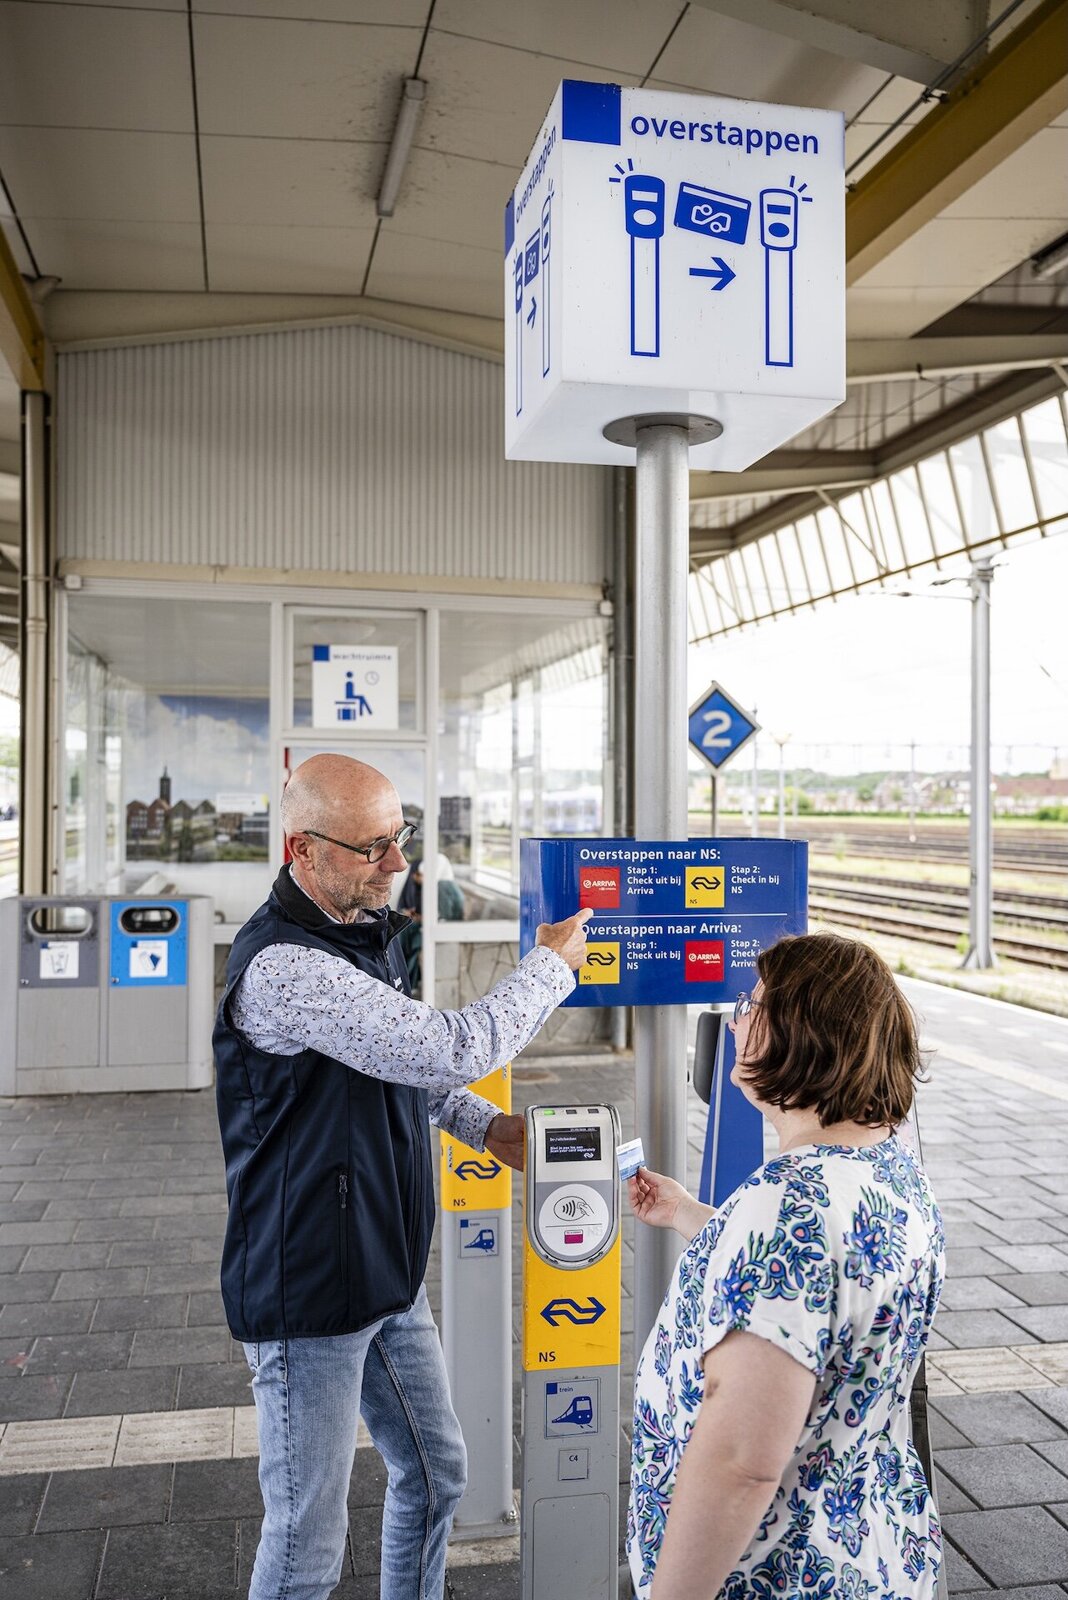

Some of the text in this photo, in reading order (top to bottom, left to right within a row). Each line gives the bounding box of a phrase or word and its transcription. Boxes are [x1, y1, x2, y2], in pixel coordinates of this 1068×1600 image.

[631, 115, 818, 156] overstappen
[516, 125, 556, 223] overstappen
[702, 709, 732, 747] 2
[580, 848, 721, 862] Overstappen naar NS:
[627, 866, 658, 876] Stap 1:
[731, 866, 760, 875] Stap 2:
[627, 876, 682, 886] Check uit bij
[731, 875, 780, 885] Check in bij
[627, 887, 654, 895] Arriva
[731, 886, 743, 894] NS
[667, 924, 696, 935] naar
[699, 922, 742, 934] Arriva:
[627, 941, 657, 950] Stap 1:
[731, 940, 750, 949] Stap
[627, 951, 681, 961] Check uit bij
[731, 950, 756, 958] Check
[627, 962, 639, 970] NS
[731, 960, 757, 968] Arriva
[453, 1198, 466, 1207] NS
[538, 1351, 556, 1362] NS
[569, 1454, 579, 1462] C4
